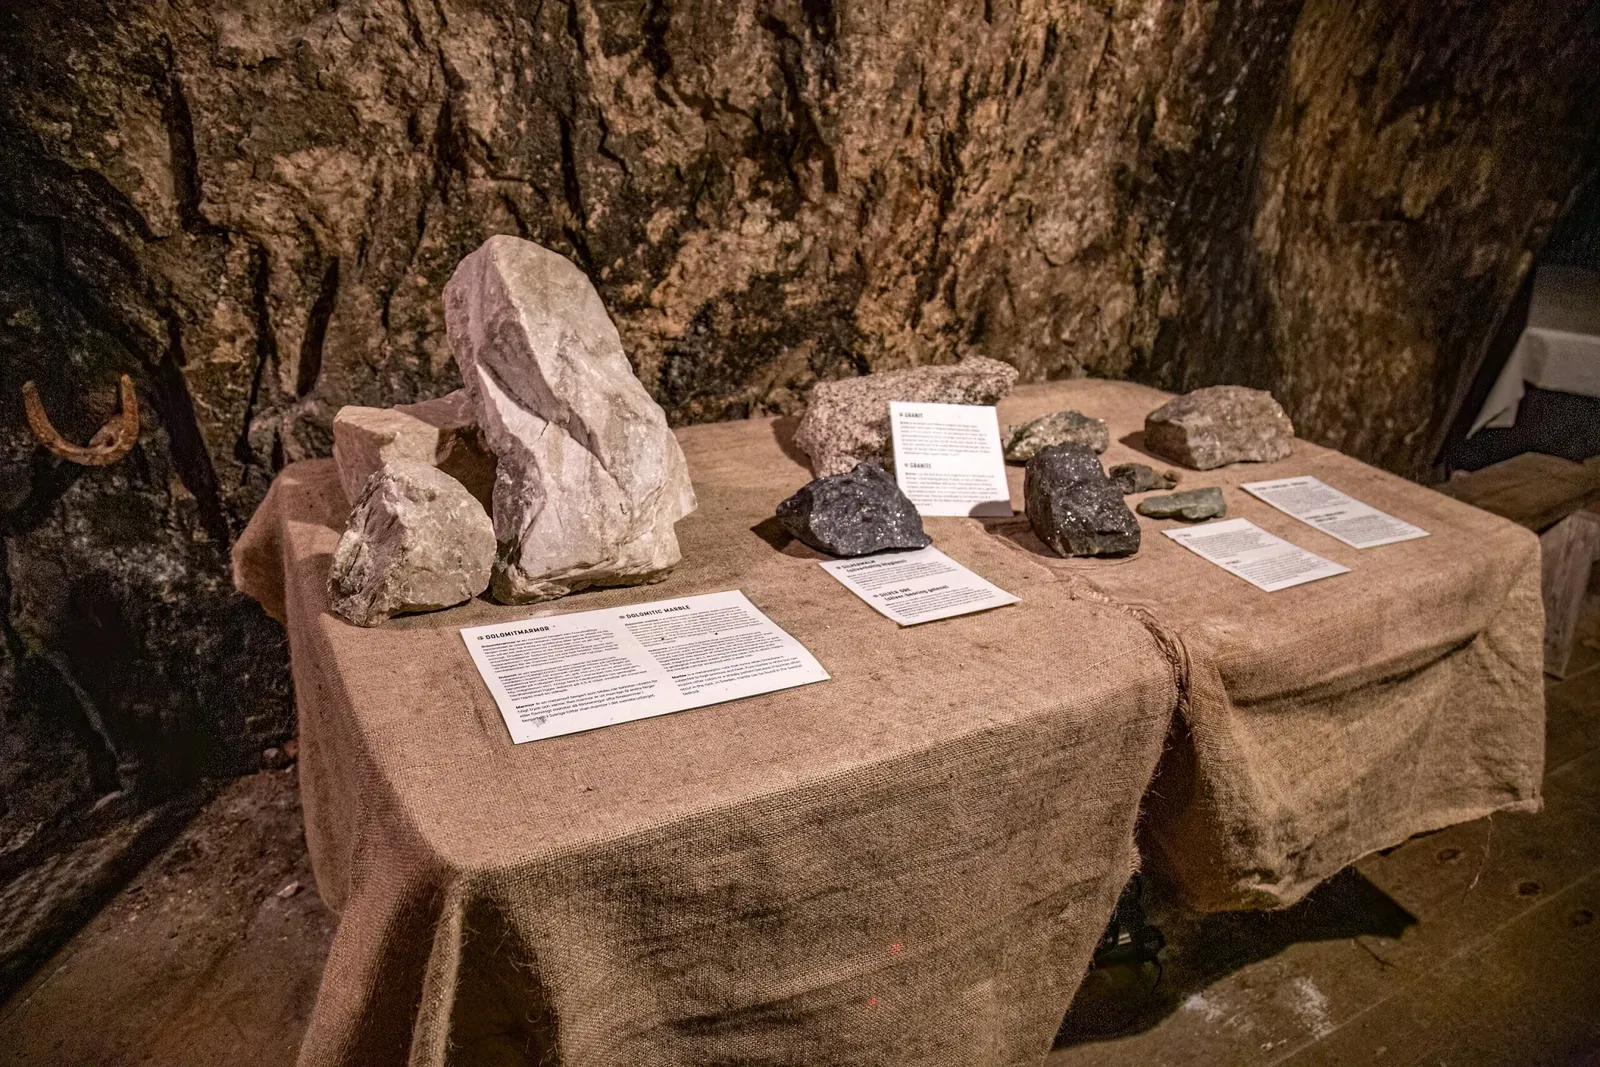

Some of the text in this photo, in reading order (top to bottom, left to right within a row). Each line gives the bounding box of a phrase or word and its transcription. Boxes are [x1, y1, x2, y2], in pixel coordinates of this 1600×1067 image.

[626, 604, 691, 619] DOLOMITIC MARBLE
[485, 626, 550, 640] DOLOMITMARMOR
